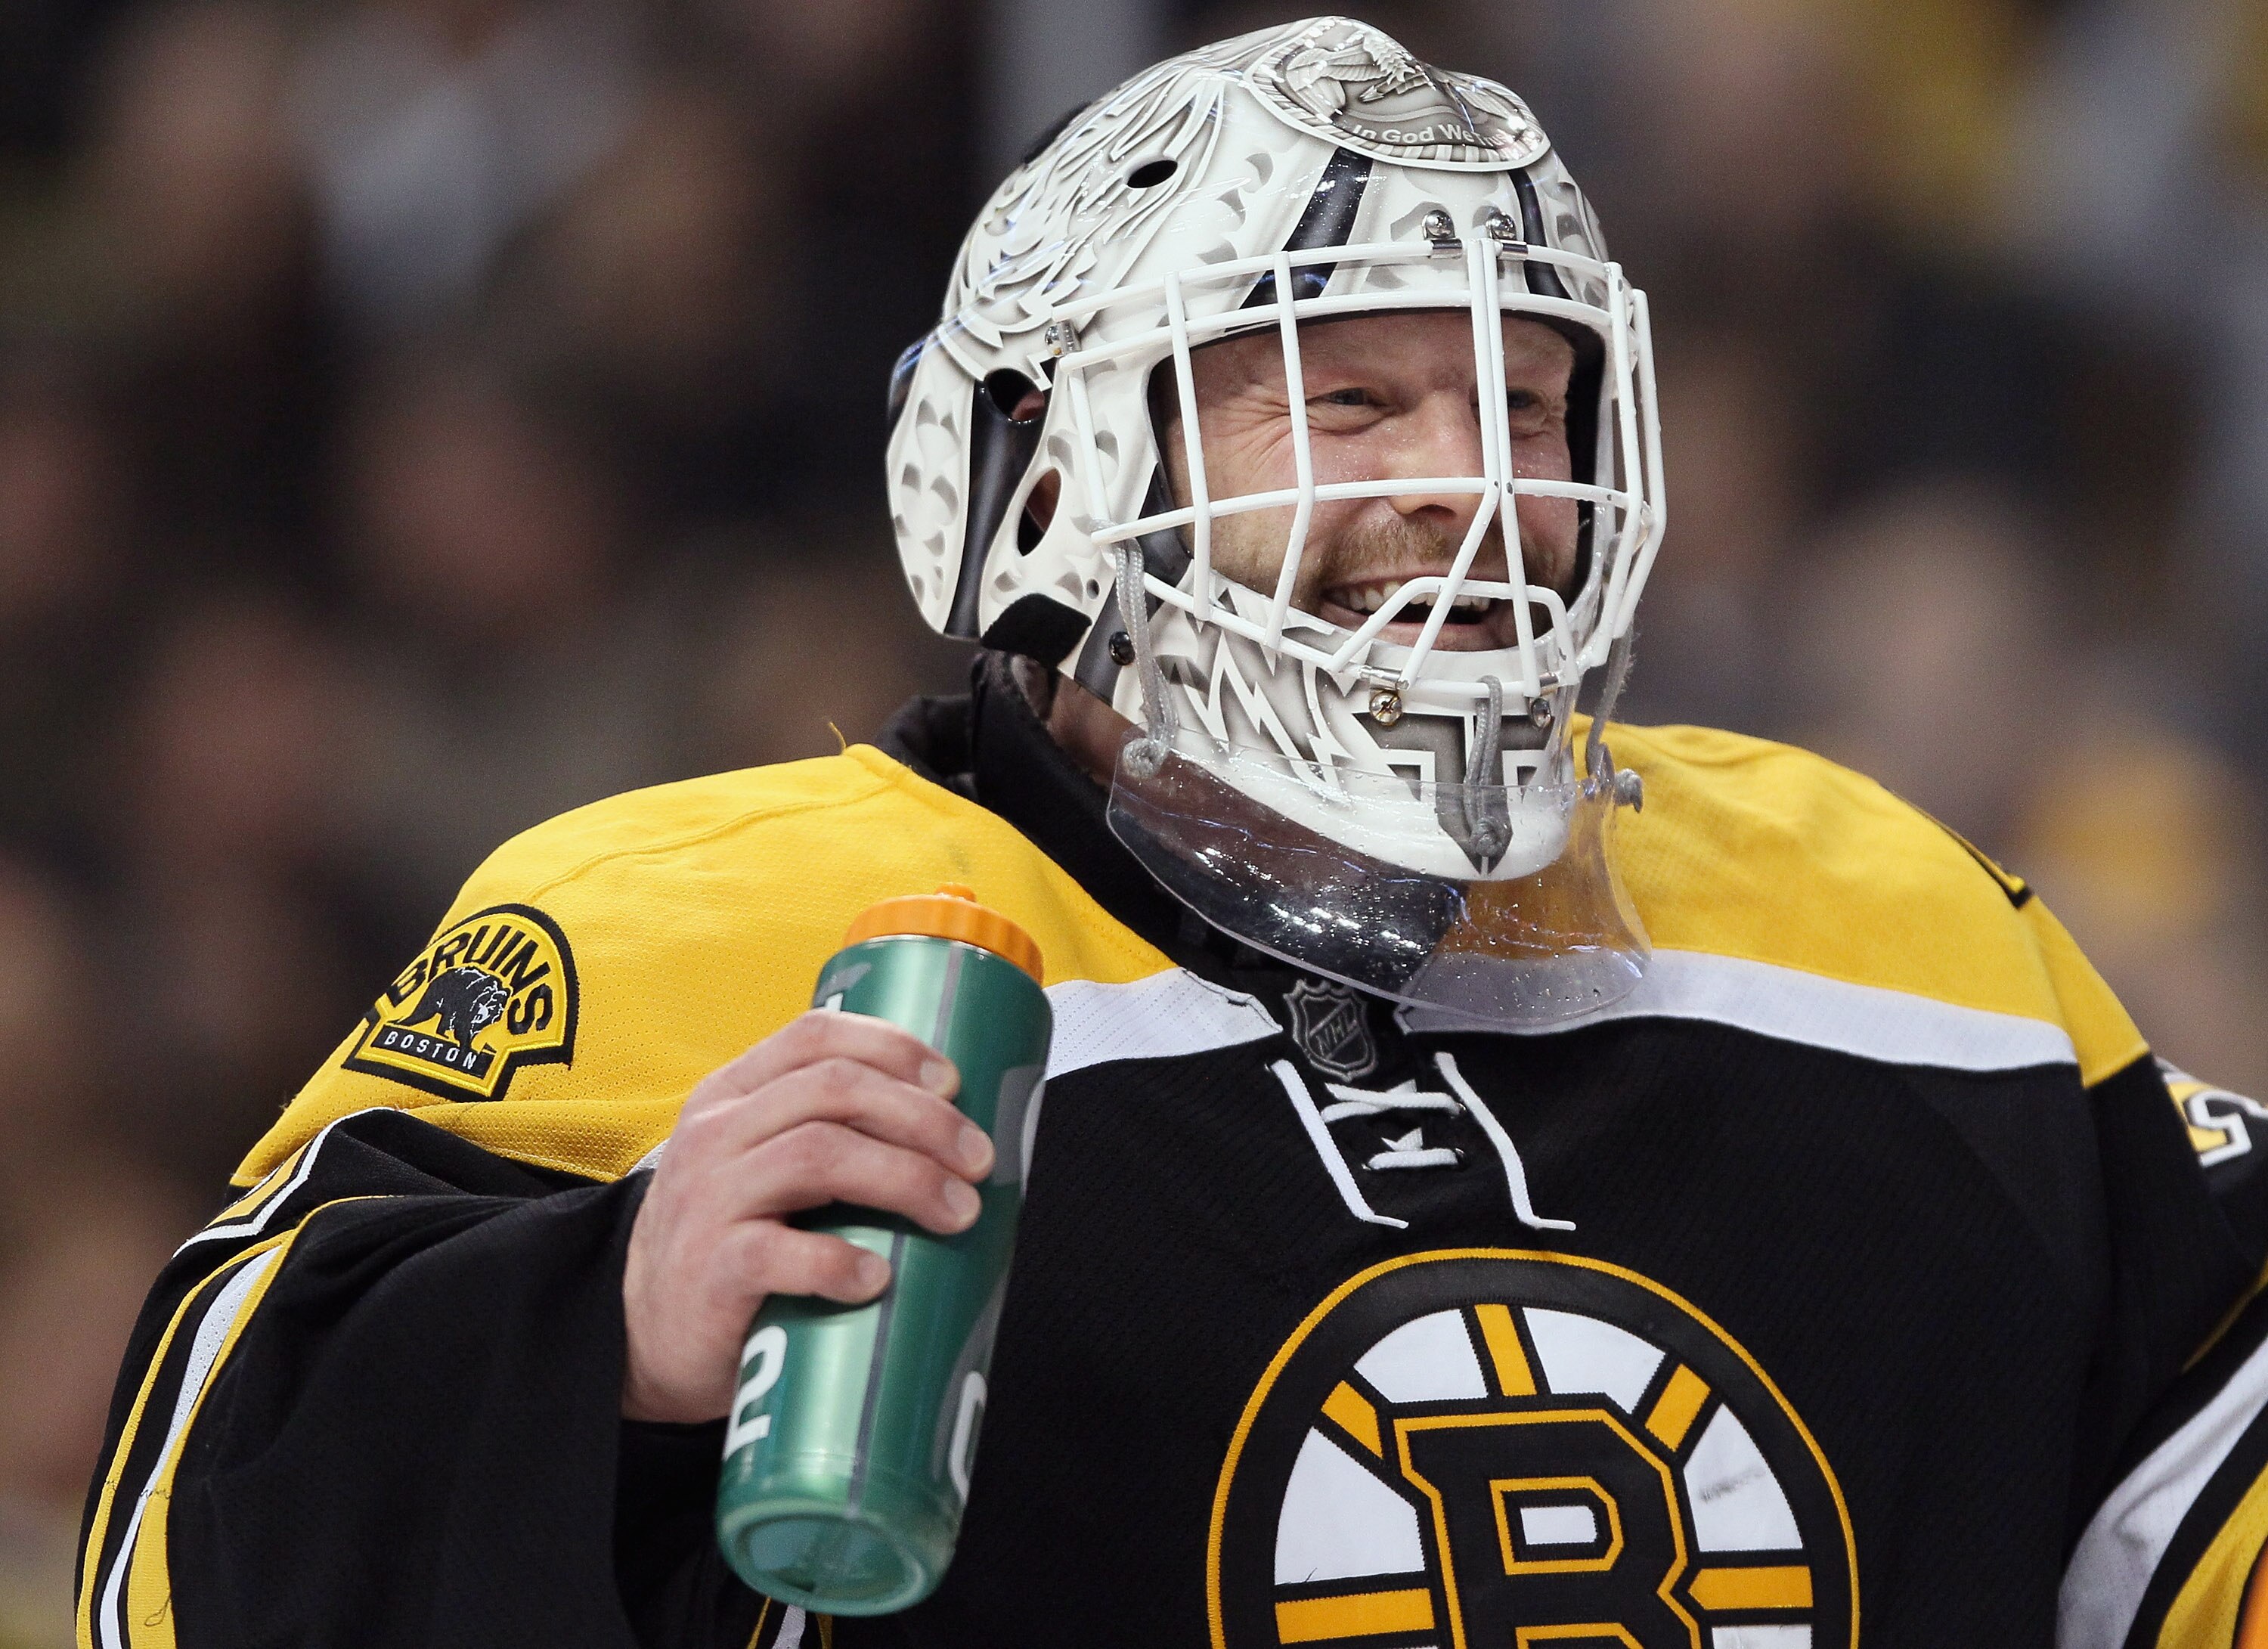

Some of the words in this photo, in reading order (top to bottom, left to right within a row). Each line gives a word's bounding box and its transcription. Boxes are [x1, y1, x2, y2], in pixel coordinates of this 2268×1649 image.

[1353, 124, 1377, 140] In
[1383, 126, 1435, 144] God
[1438, 123, 1473, 142] We
[386, 924, 553, 1036] BRUINS
[384, 1031, 477, 1070] BOSTON
[1315, 1010, 1358, 1056] NHL
[1393, 1409, 1701, 1649] B
